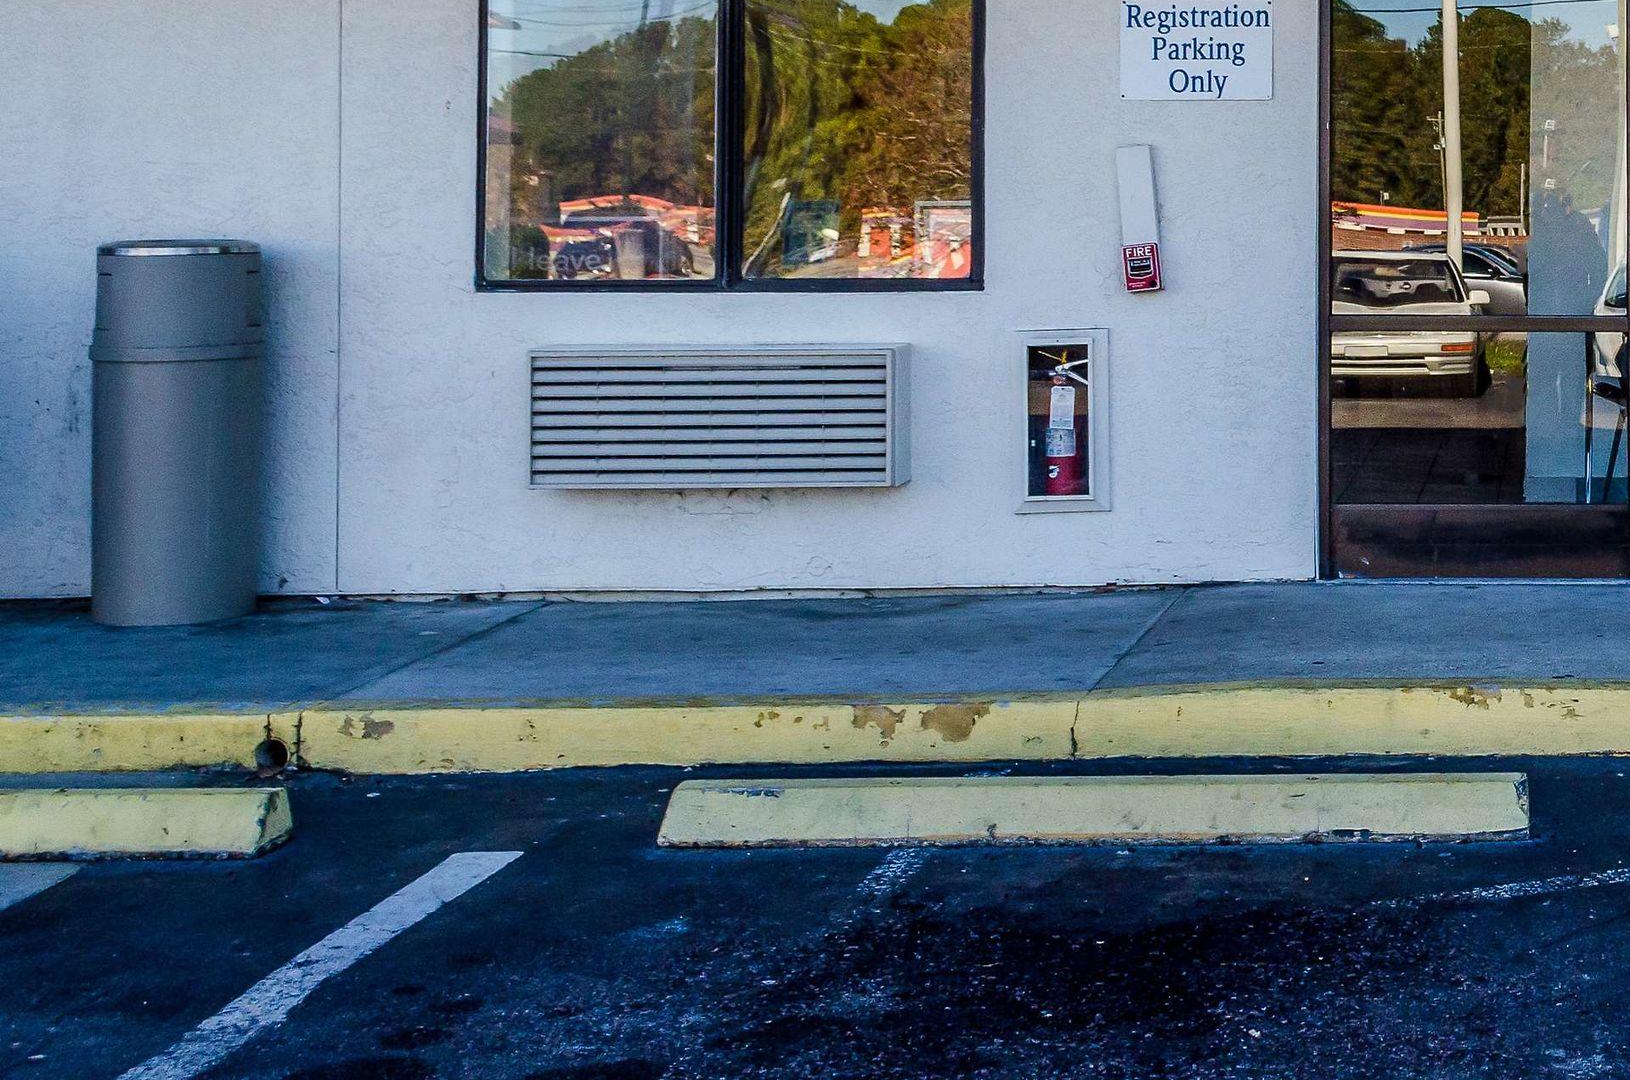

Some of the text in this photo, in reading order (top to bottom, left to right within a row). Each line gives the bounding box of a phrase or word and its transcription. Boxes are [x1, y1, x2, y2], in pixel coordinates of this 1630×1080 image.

[1125, 3, 1271, 35] Registration
[1151, 36, 1246, 67] Parking
[1168, 68, 1229, 99] Only
[1125, 246, 1153, 258] FIRE
